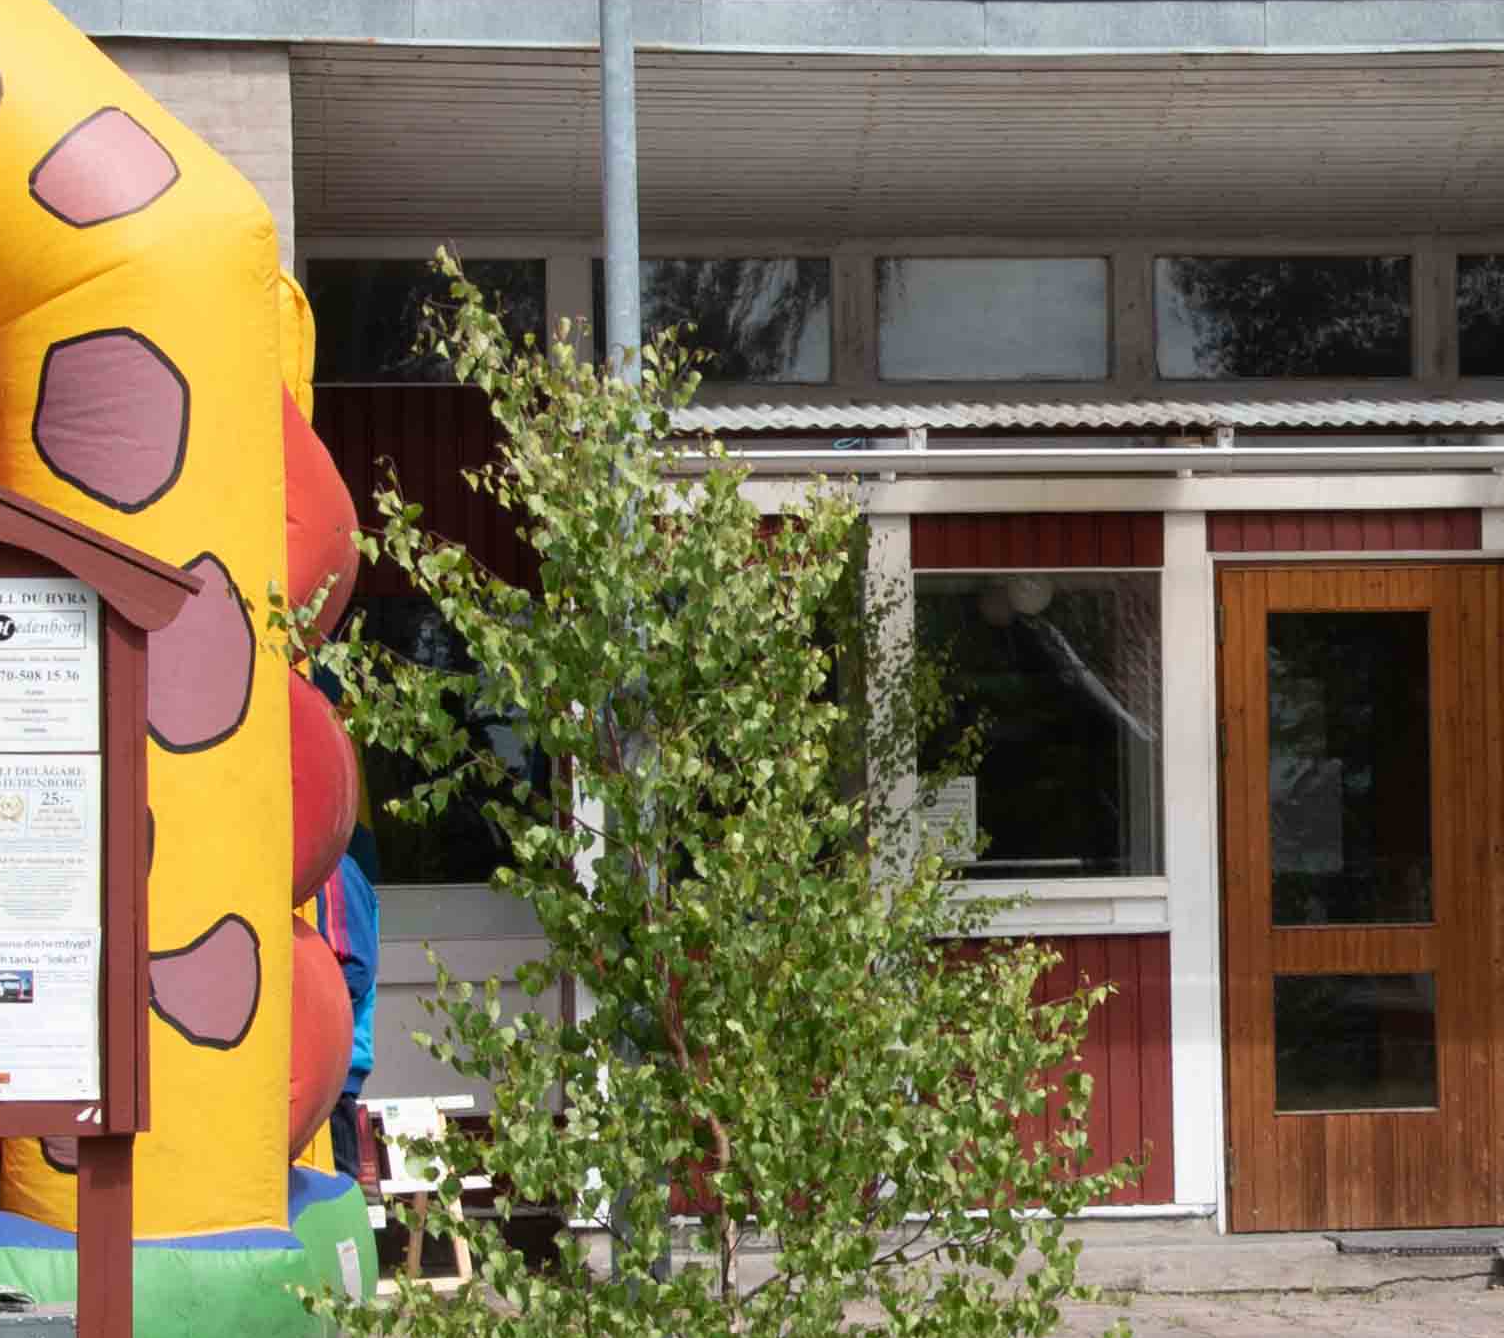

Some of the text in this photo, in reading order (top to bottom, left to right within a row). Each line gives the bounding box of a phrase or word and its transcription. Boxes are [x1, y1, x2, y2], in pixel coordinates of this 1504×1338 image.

[22, 591, 42, 604] DU
[45, 591, 88, 604] HYRA
[39, 790, 73, 806] 25:-
